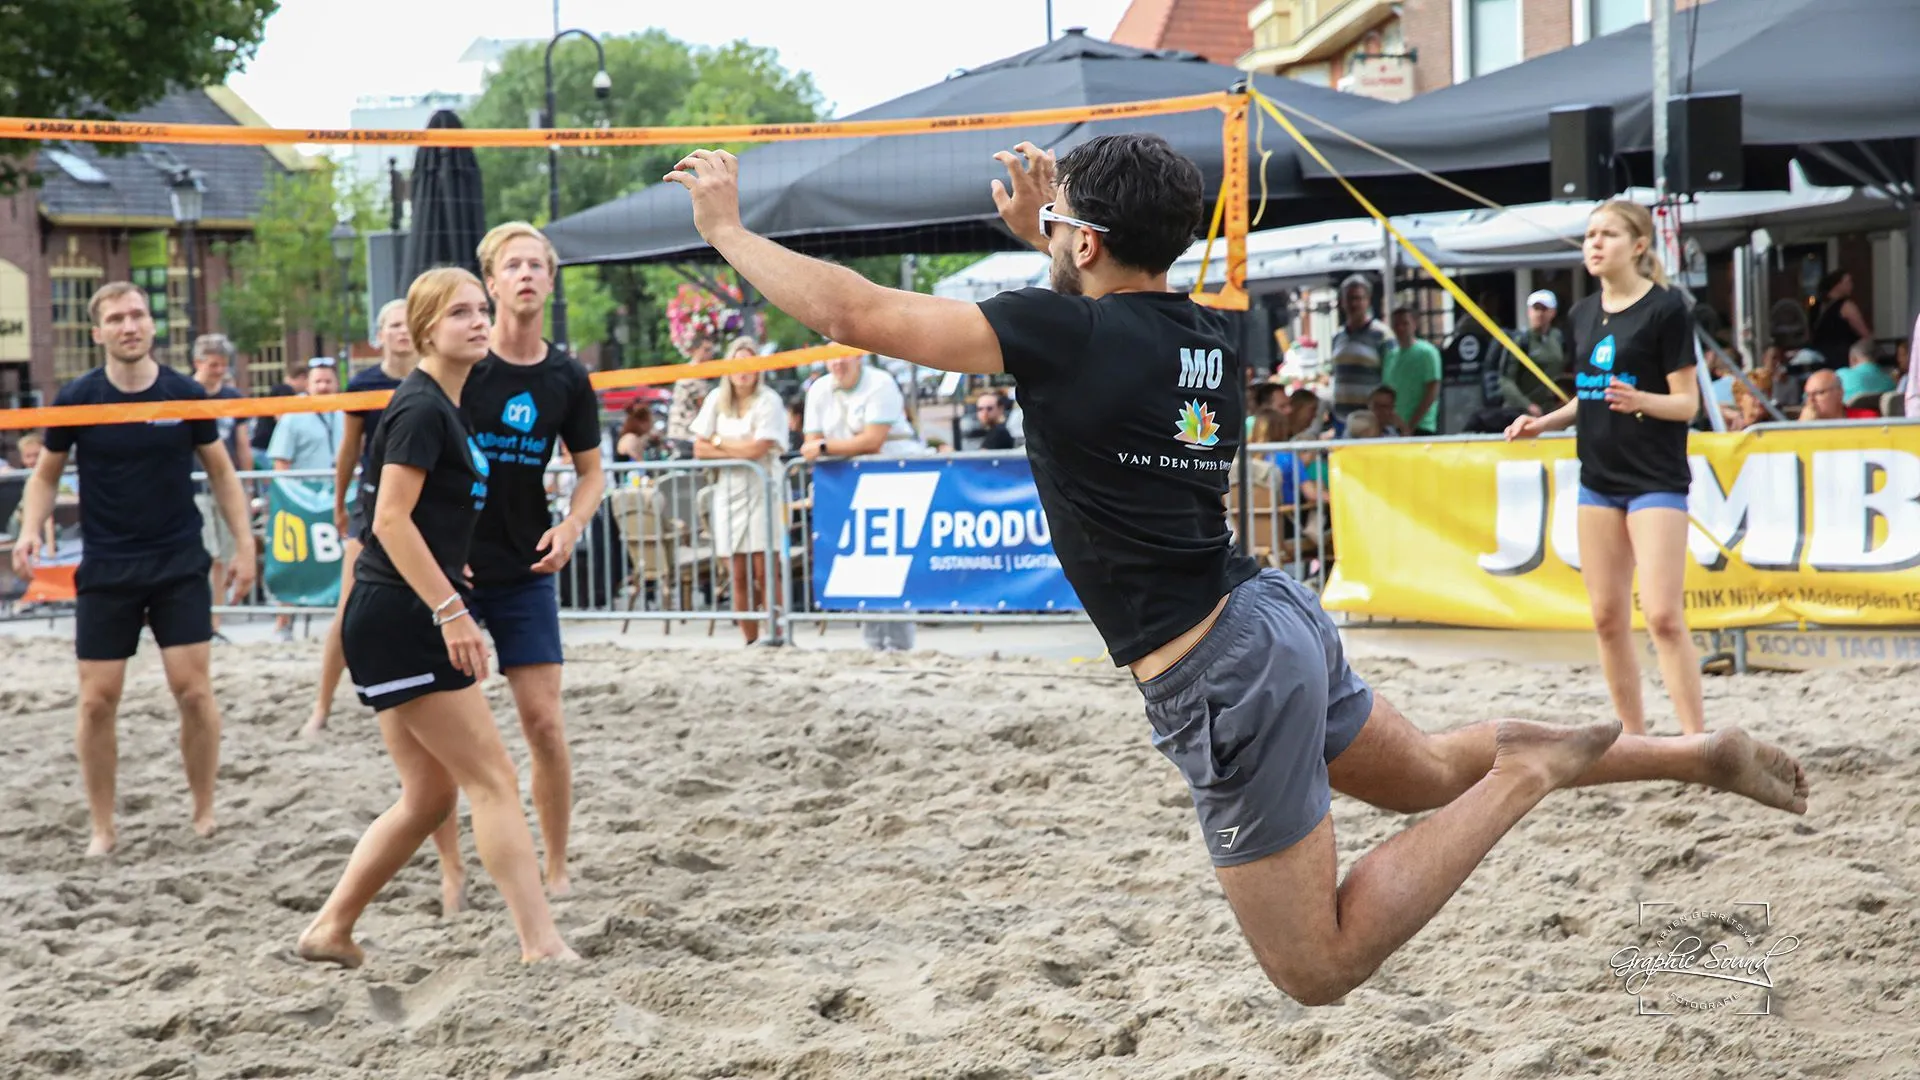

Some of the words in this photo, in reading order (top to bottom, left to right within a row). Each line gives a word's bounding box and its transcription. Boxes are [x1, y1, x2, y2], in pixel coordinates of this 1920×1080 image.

[39, 122, 76, 134] PARK
[79, 123, 89, 134] &
[1178, 347, 1223, 390] MO
[1117, 452, 1152, 466] VAN
[1159, 455, 1190, 470] DEN
[1477, 449, 1920, 576] JMB
[931, 509, 1051, 549] PRODU
[929, 554, 1004, 572] SUSTAINABLE
[1797, 587, 1900, 612] Molenplein
